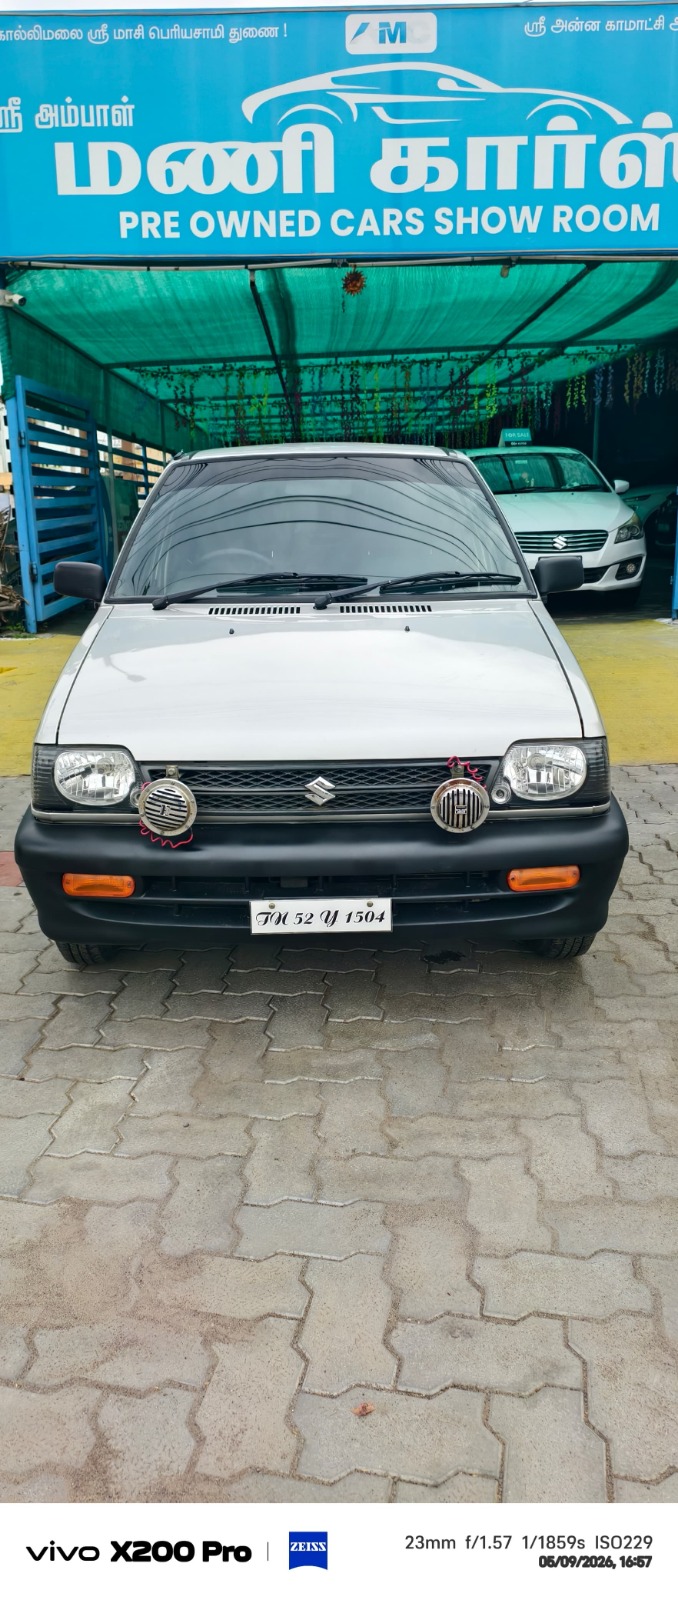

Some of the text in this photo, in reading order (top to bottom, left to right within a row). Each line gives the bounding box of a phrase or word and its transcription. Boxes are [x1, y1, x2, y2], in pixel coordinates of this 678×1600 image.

[113, 24, 145, 40] மாசி
[148, 23, 225, 40] பெரியசாமி
[228, 25, 279, 44] துணை
[550, 16, 601, 33] அன்ன
[605, 14, 665, 31] காமாட்சி
[34, 95, 135, 129] அம்பாள்
[54, 123, 335, 196] மணி
[119, 203, 660, 239] PRE OWNED CARS SHOW ROOM
[255, 909, 386, 928] TN 52 Y 1504
